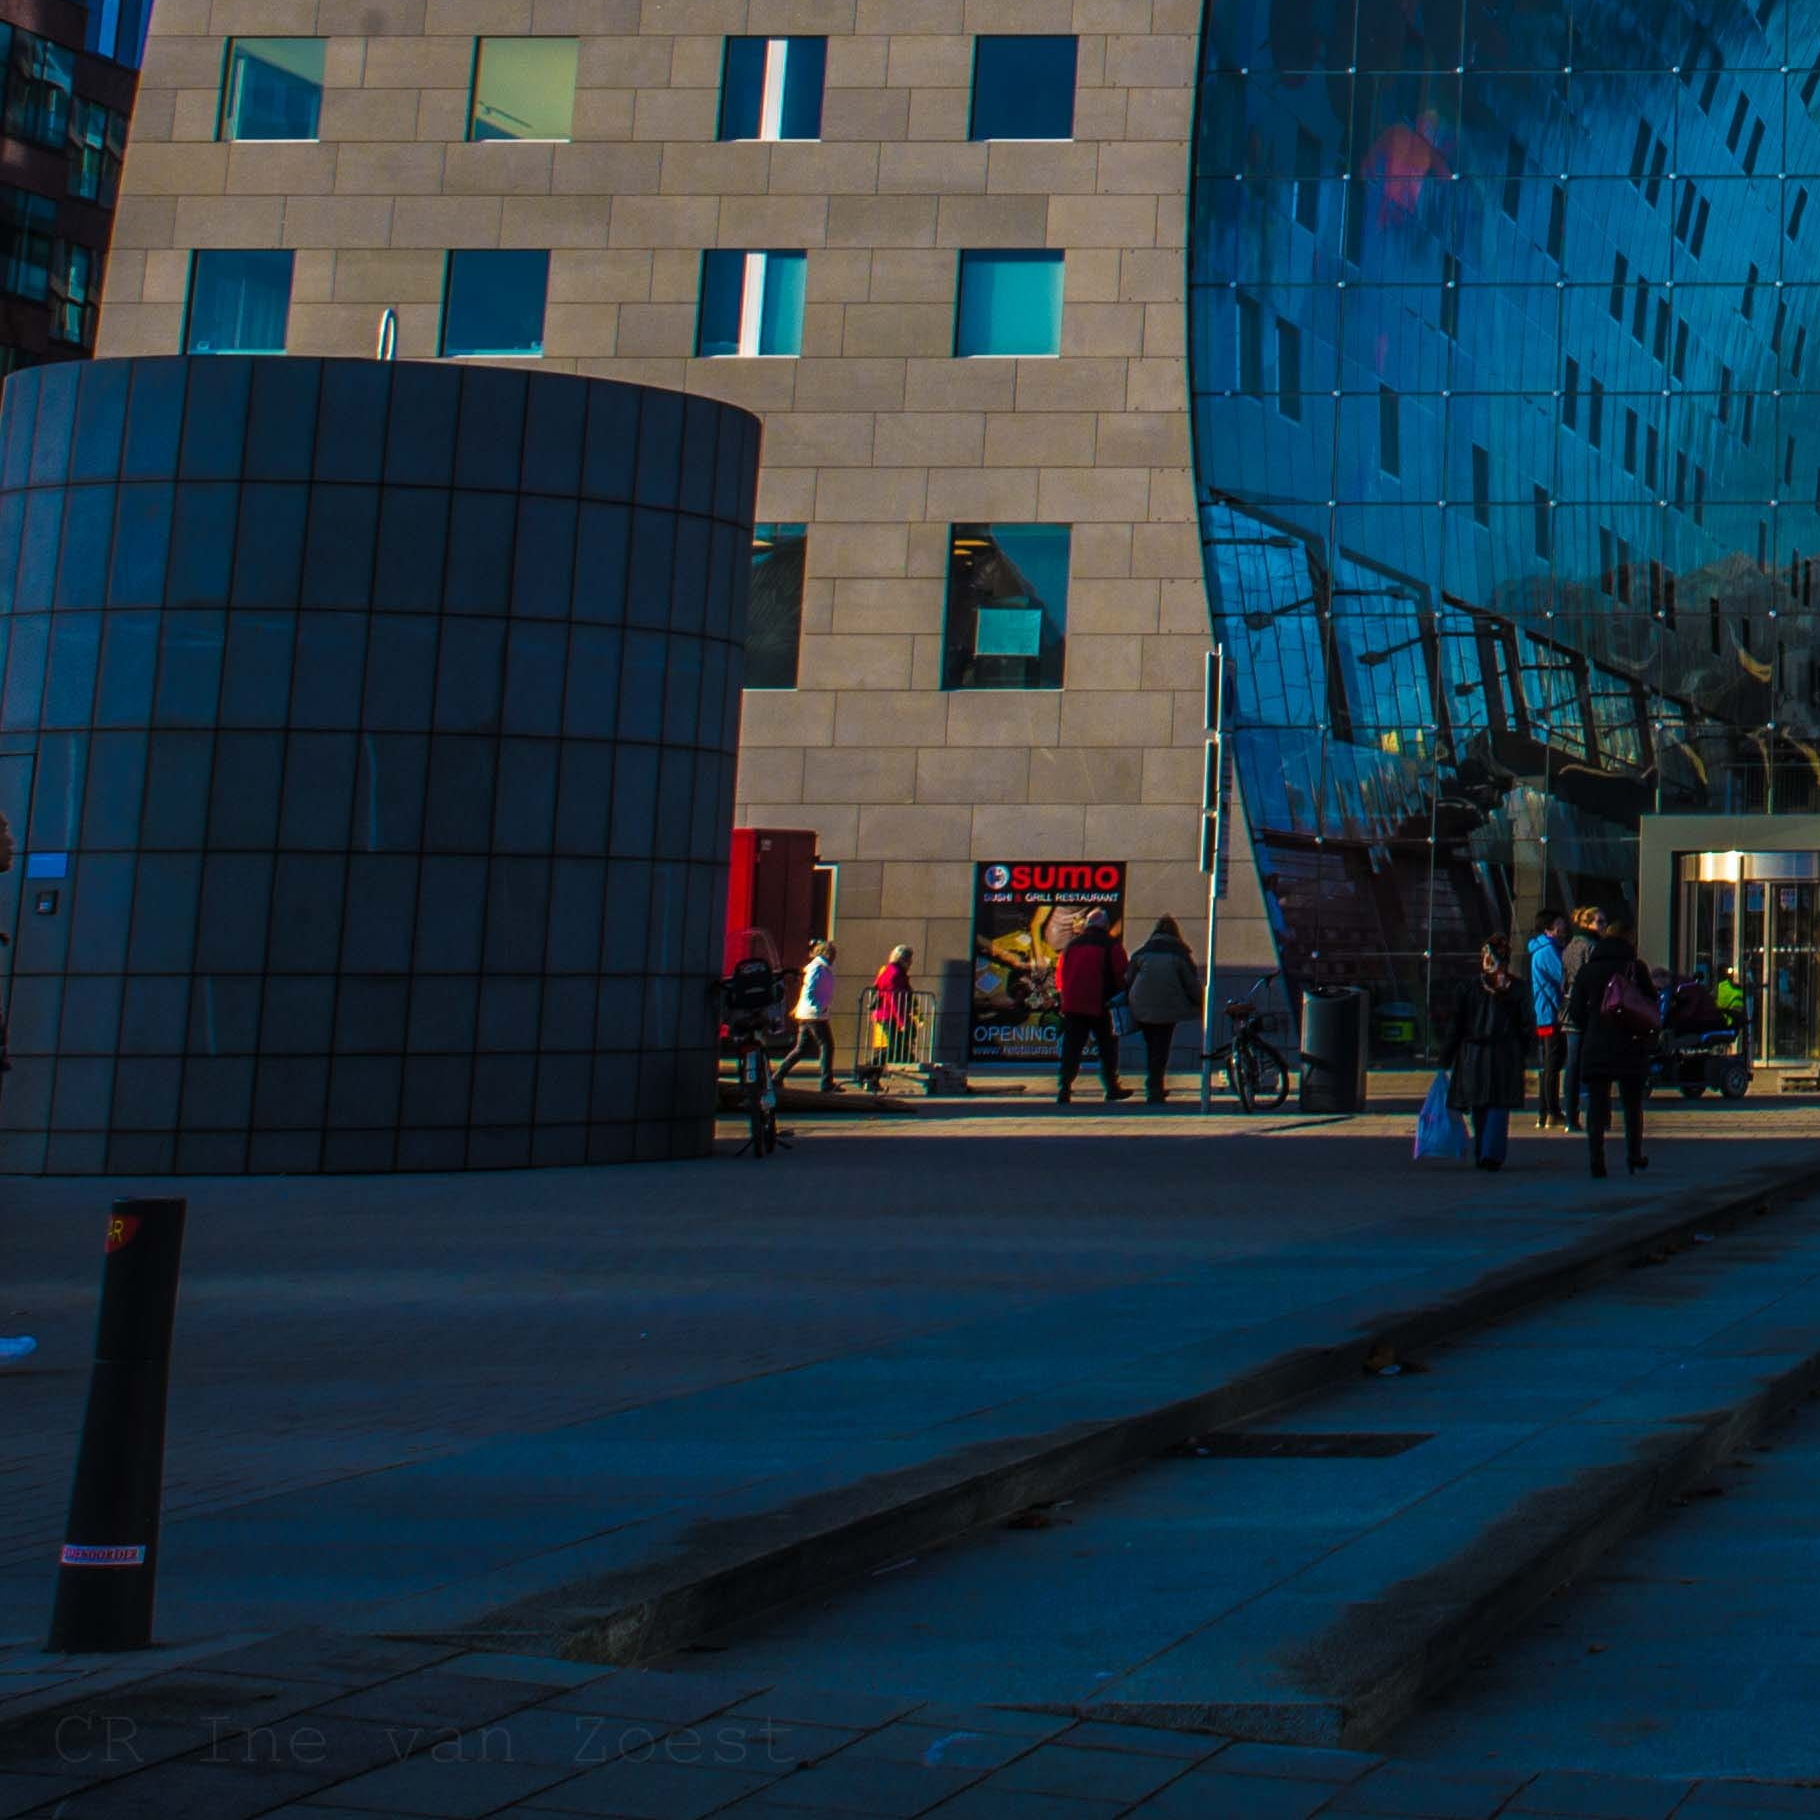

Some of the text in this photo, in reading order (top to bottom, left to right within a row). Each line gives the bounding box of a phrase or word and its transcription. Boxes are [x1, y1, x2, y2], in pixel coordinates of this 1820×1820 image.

[1025, 892, 1052, 902] GRILL
[1055, 891, 1120, 902] RESTAURANT
[973, 1025, 1057, 1042] OPENING
